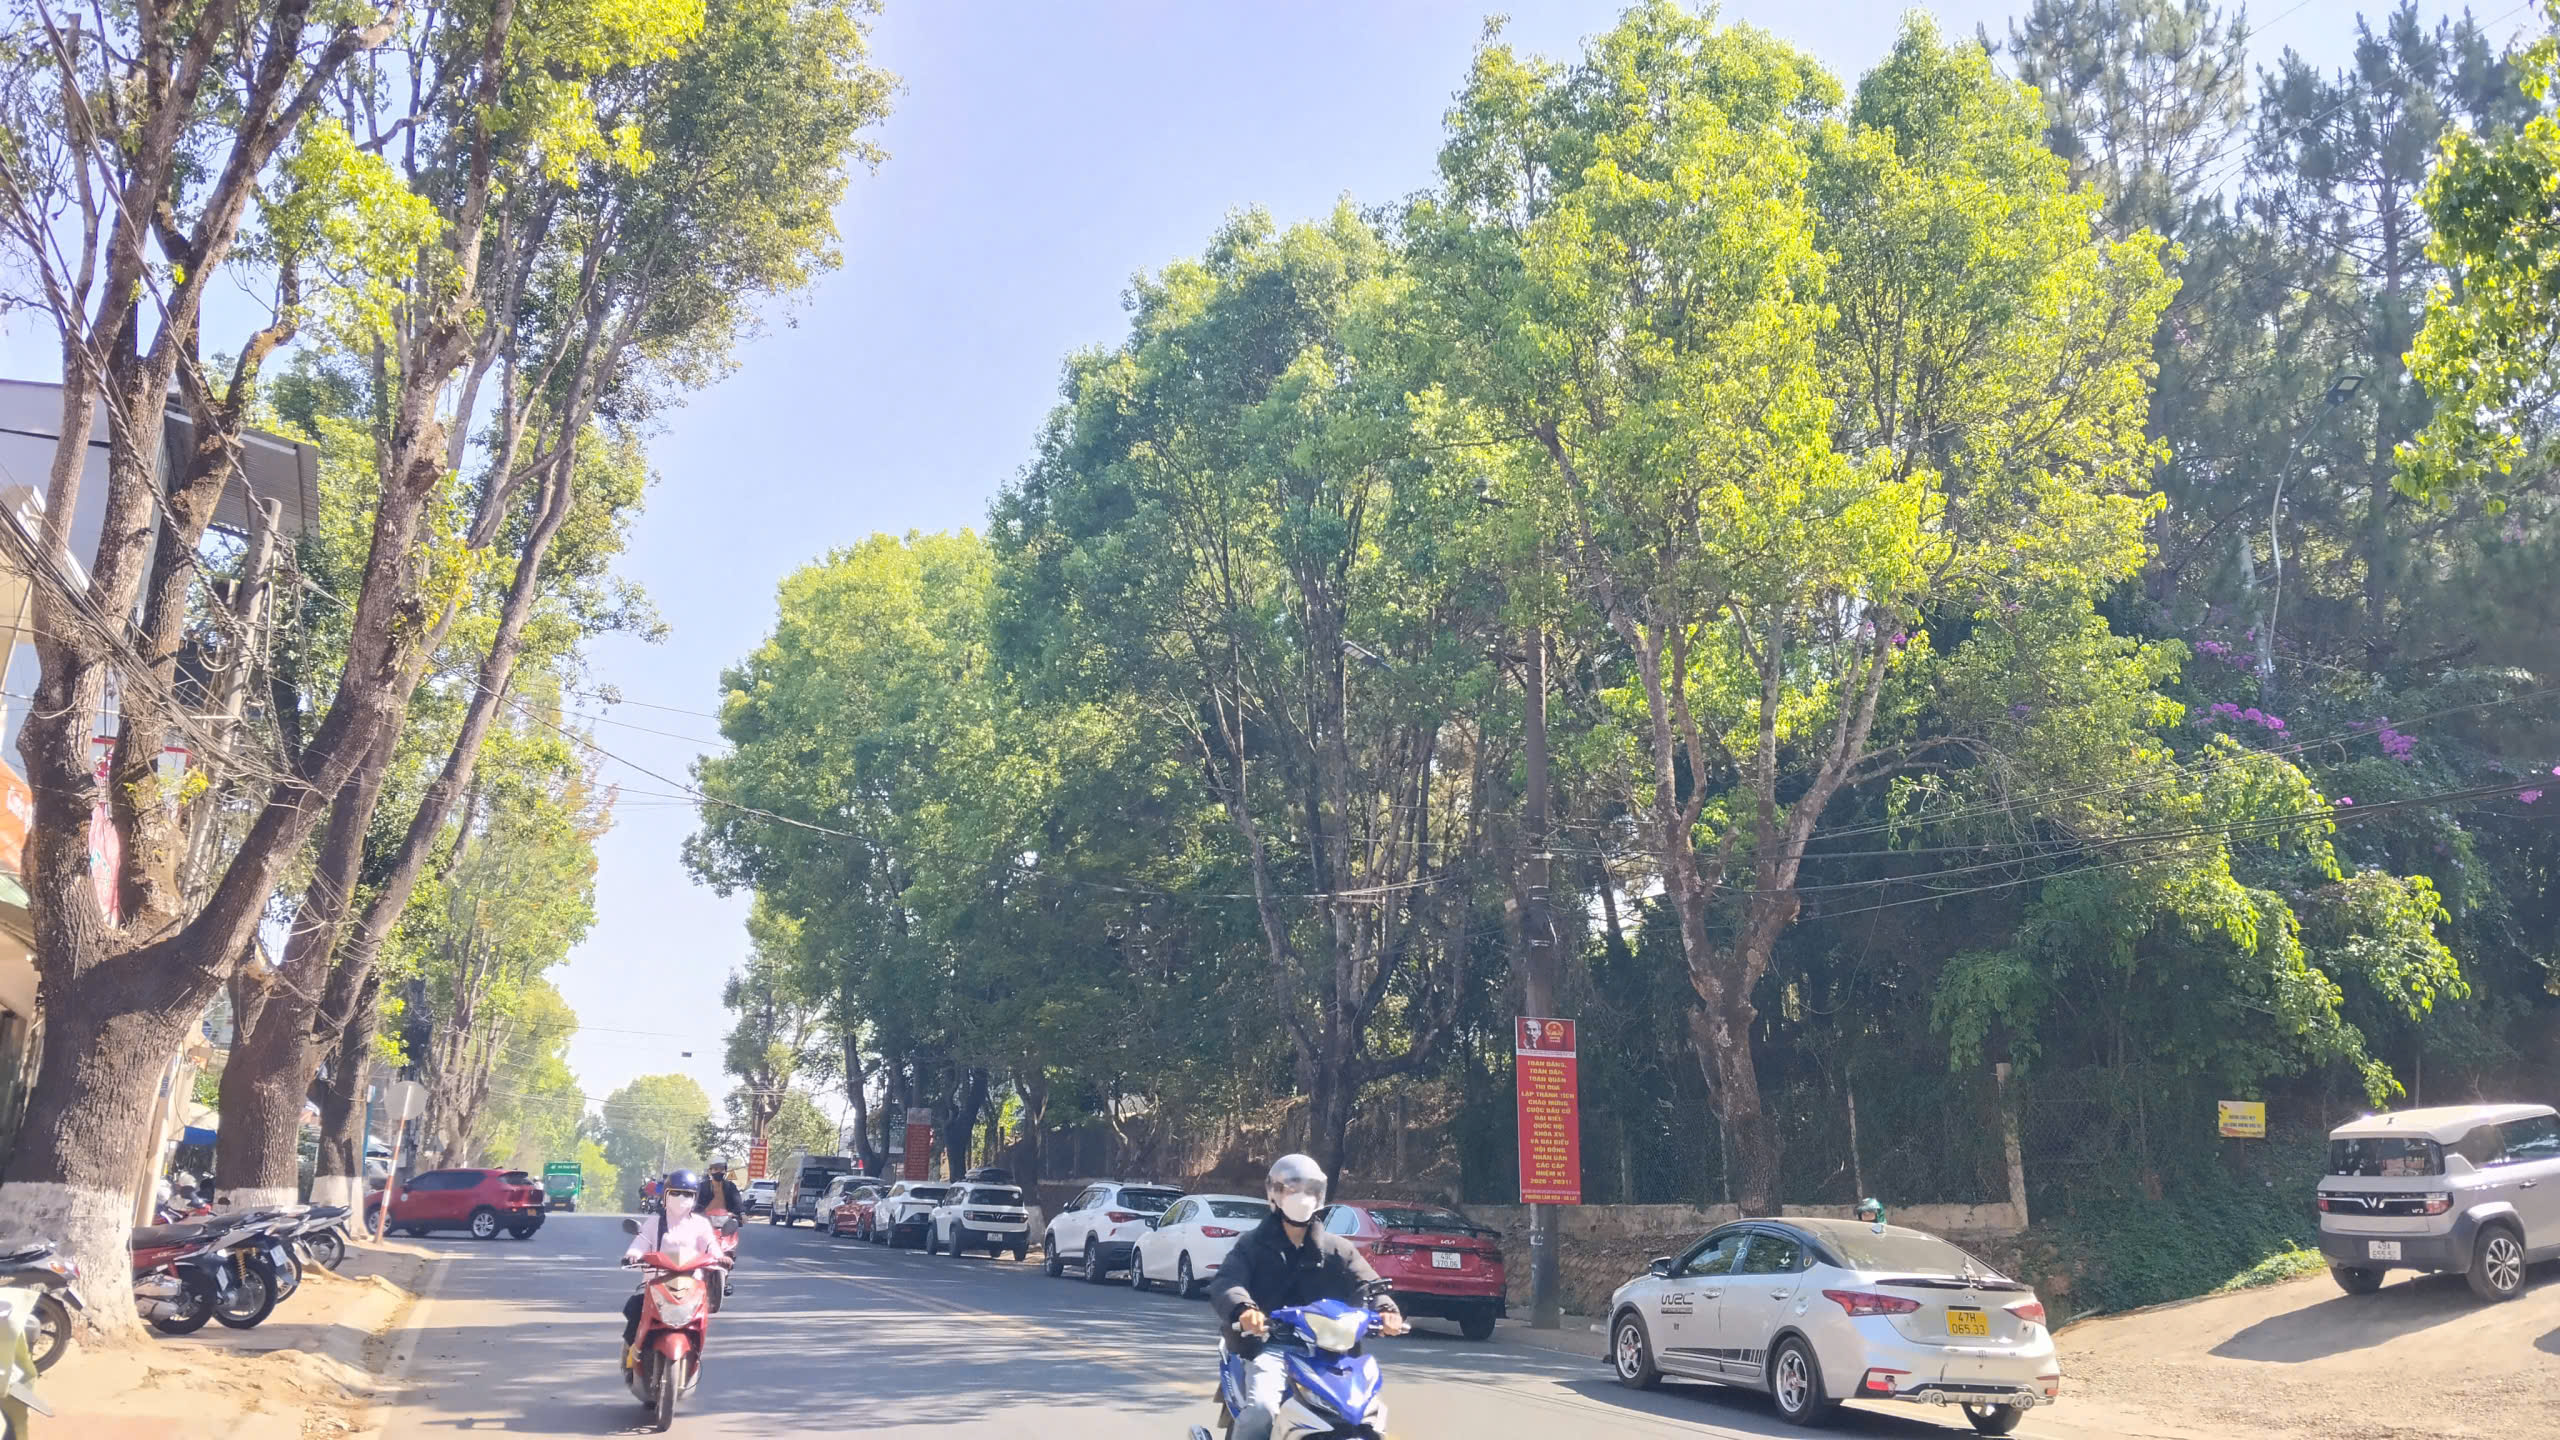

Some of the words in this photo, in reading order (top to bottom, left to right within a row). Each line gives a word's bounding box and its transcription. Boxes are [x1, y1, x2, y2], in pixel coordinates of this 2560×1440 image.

[1661, 1292, 1695, 1305] WRC
[1958, 1312, 1976, 1322] 47H
[1951, 1323, 1985, 1335] 065.33
